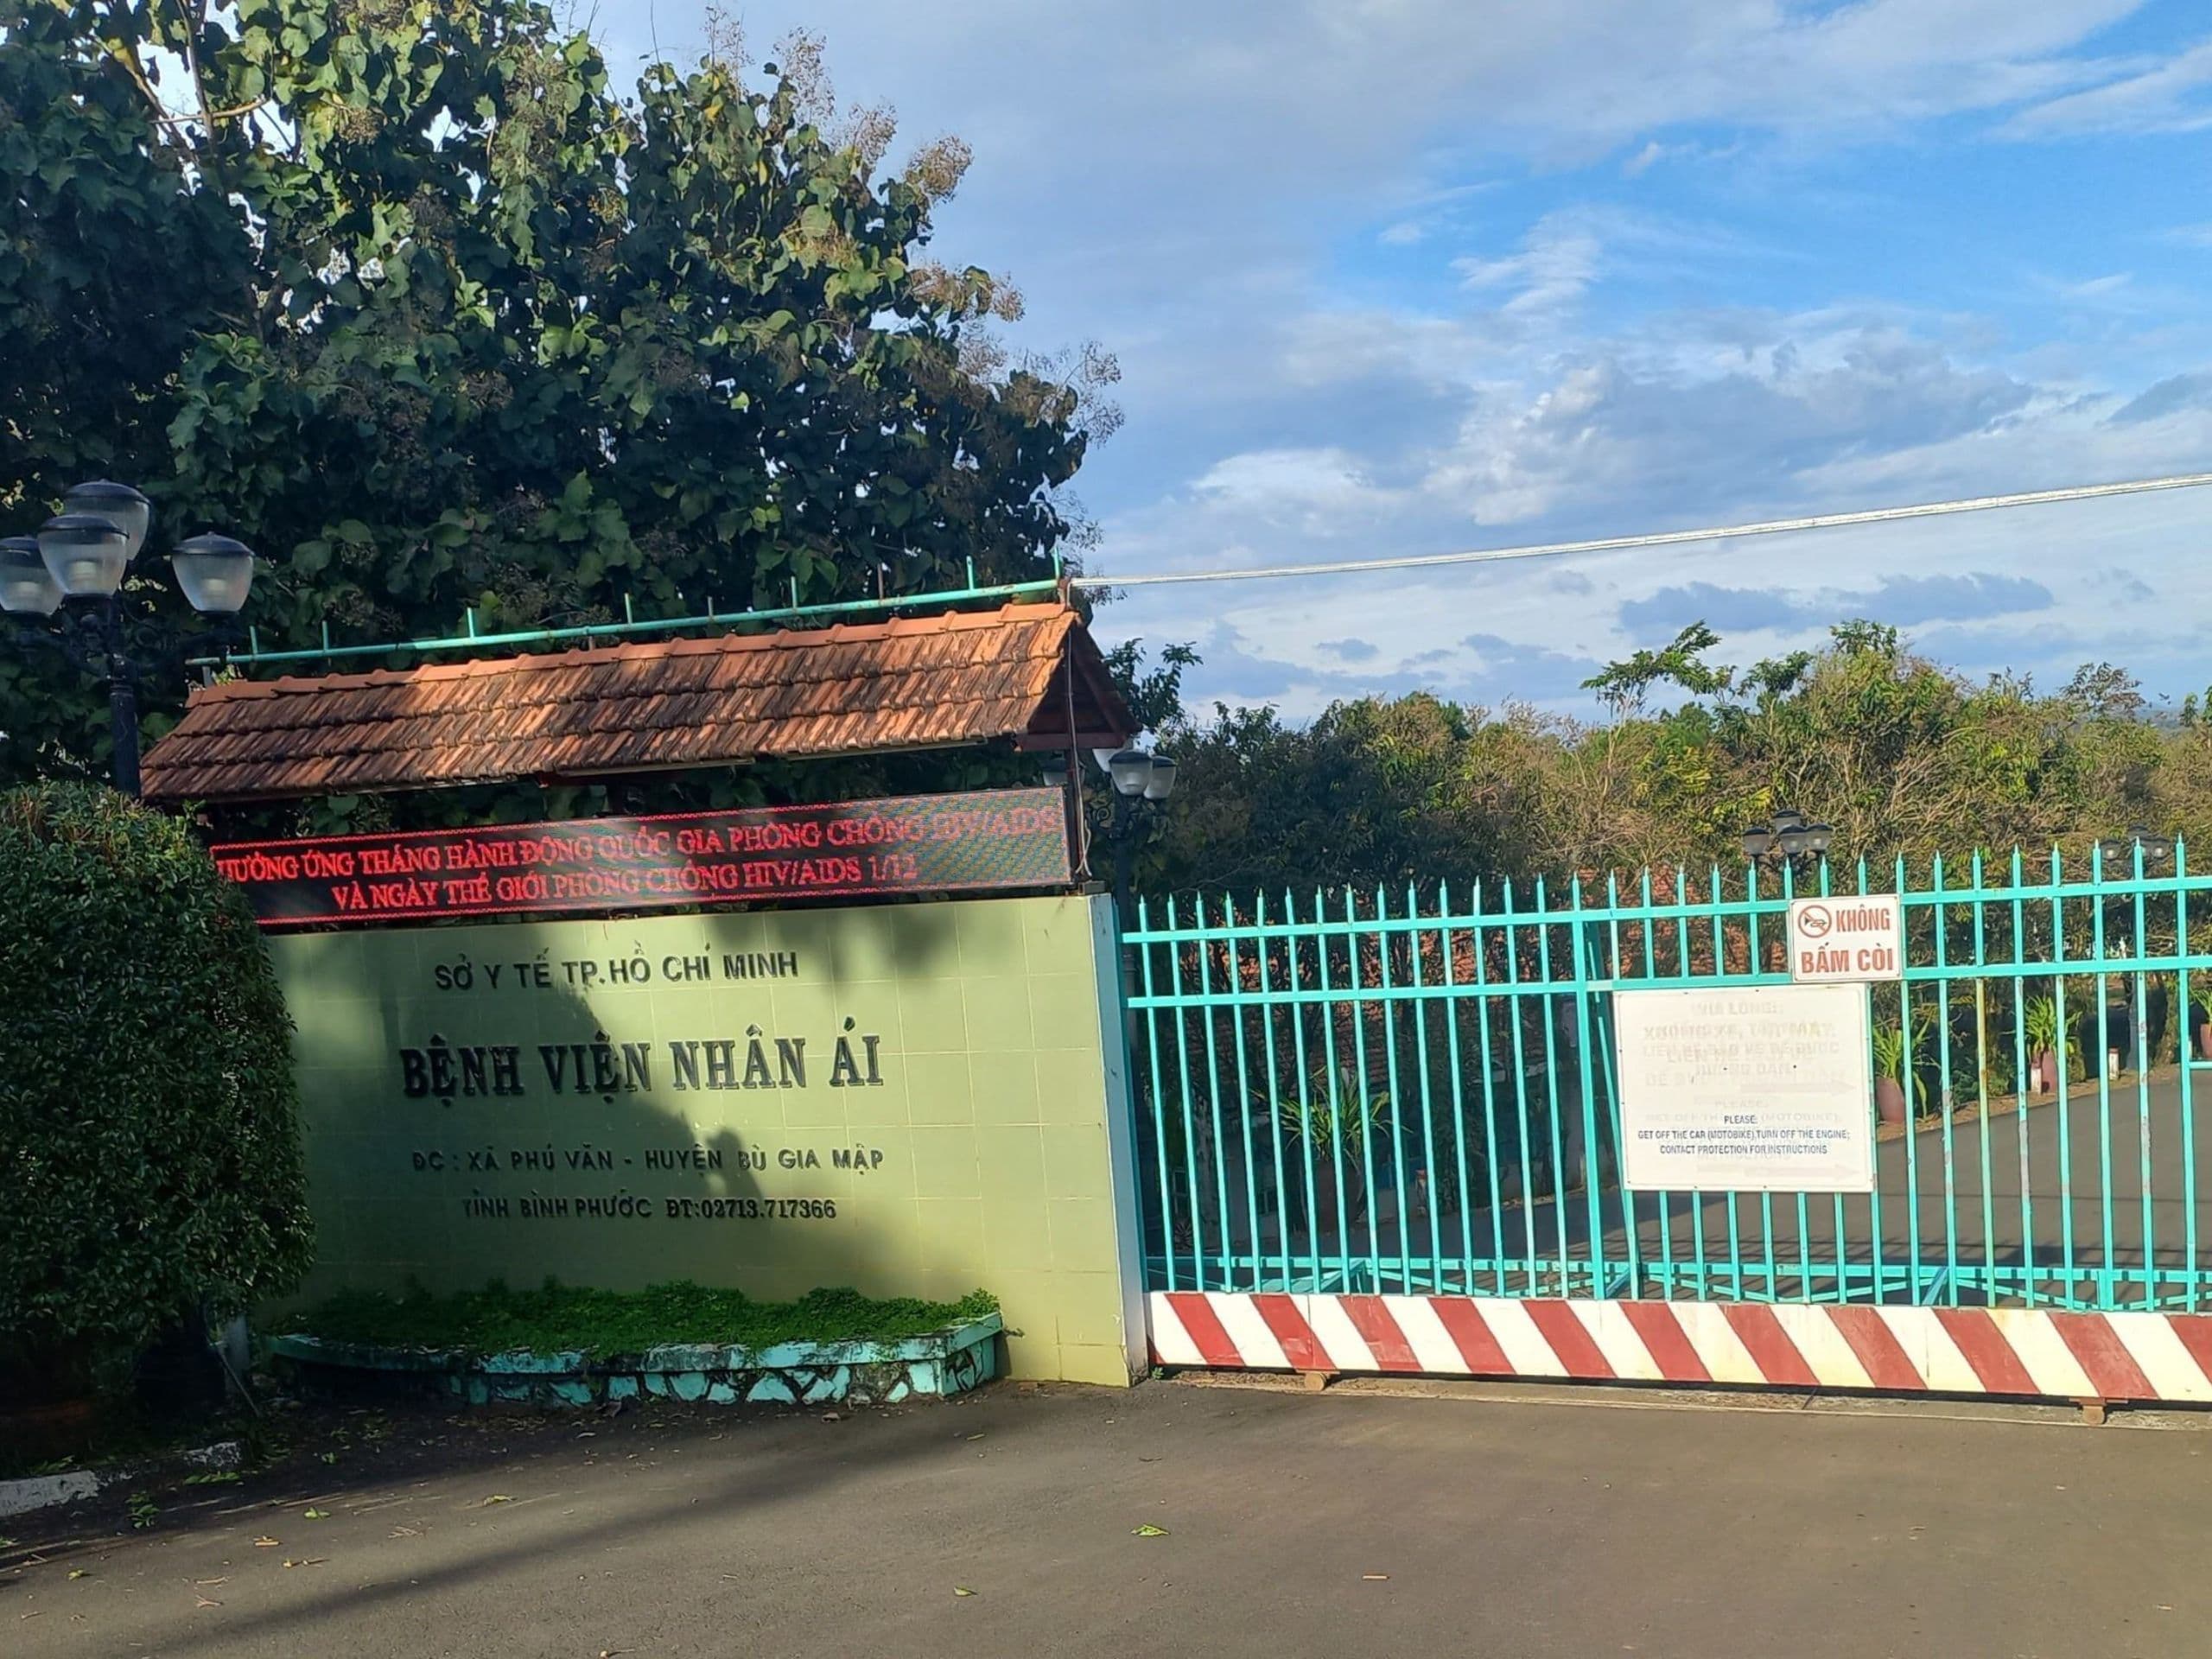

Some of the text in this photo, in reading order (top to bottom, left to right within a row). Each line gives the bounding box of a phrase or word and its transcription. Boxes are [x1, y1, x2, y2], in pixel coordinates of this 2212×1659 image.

[301, 849, 355, 878] ỨNG
[359, 842, 441, 875] THÁNG
[445, 839, 518, 870] HÀNH
[519, 836, 594, 867] ĐỘNG
[677, 829, 726, 855] GIA
[728, 821, 822, 852] PHÒNG
[332, 880, 369, 910] VÀ
[369, 877, 439, 907] NGÀY
[443, 871, 493, 905] THẾ
[496, 869, 549, 901] GIỚI
[551, 867, 640, 899] PHÒNG
[645, 858, 739, 893] CHỐNG
[743, 856, 862, 888] HIV/AIDS
[1835, 904, 1891, 933] KHÔNG
[434, 953, 474, 990] SỞ
[484, 963, 503, 989] Y
[513, 947, 552, 988] TẾ
[663, 942, 713, 982] CHÍ
[722, 951, 798, 979] MINH
[1801, 941, 1893, 974] BẤM CÒI
[400, 1015, 883, 1109] BỆNH VIỆN NHÂN ÁI
[1637, 1129, 1653, 1140] GET
[1655, 1129, 1670, 1140] OFF
[1672, 1129, 1688, 1139] THE
[1689, 1129, 1706, 1139] CAR
[1780, 1129, 1796, 1139] OFF
[1798, 1128, 1814, 1139] THE
[1659, 1145, 1827, 1154] CONTACT PROTECTION FOR INSTRUCTIONS
[467, 1146, 499, 1171] XÃ
[511, 1143, 555, 1171] PHÚ
[564, 1142, 614, 1170] VĂN
[645, 1143, 723, 1177] HUYỆN
[737, 1144, 767, 1171] BÙ
[778, 1149, 821, 1170] GIA
[832, 1142, 884, 1176] MẬP
[461, 1188, 510, 1218] TỈNH
[519, 1189, 569, 1217] BÌNH
[574, 1187, 653, 1218] PHƯỚC
